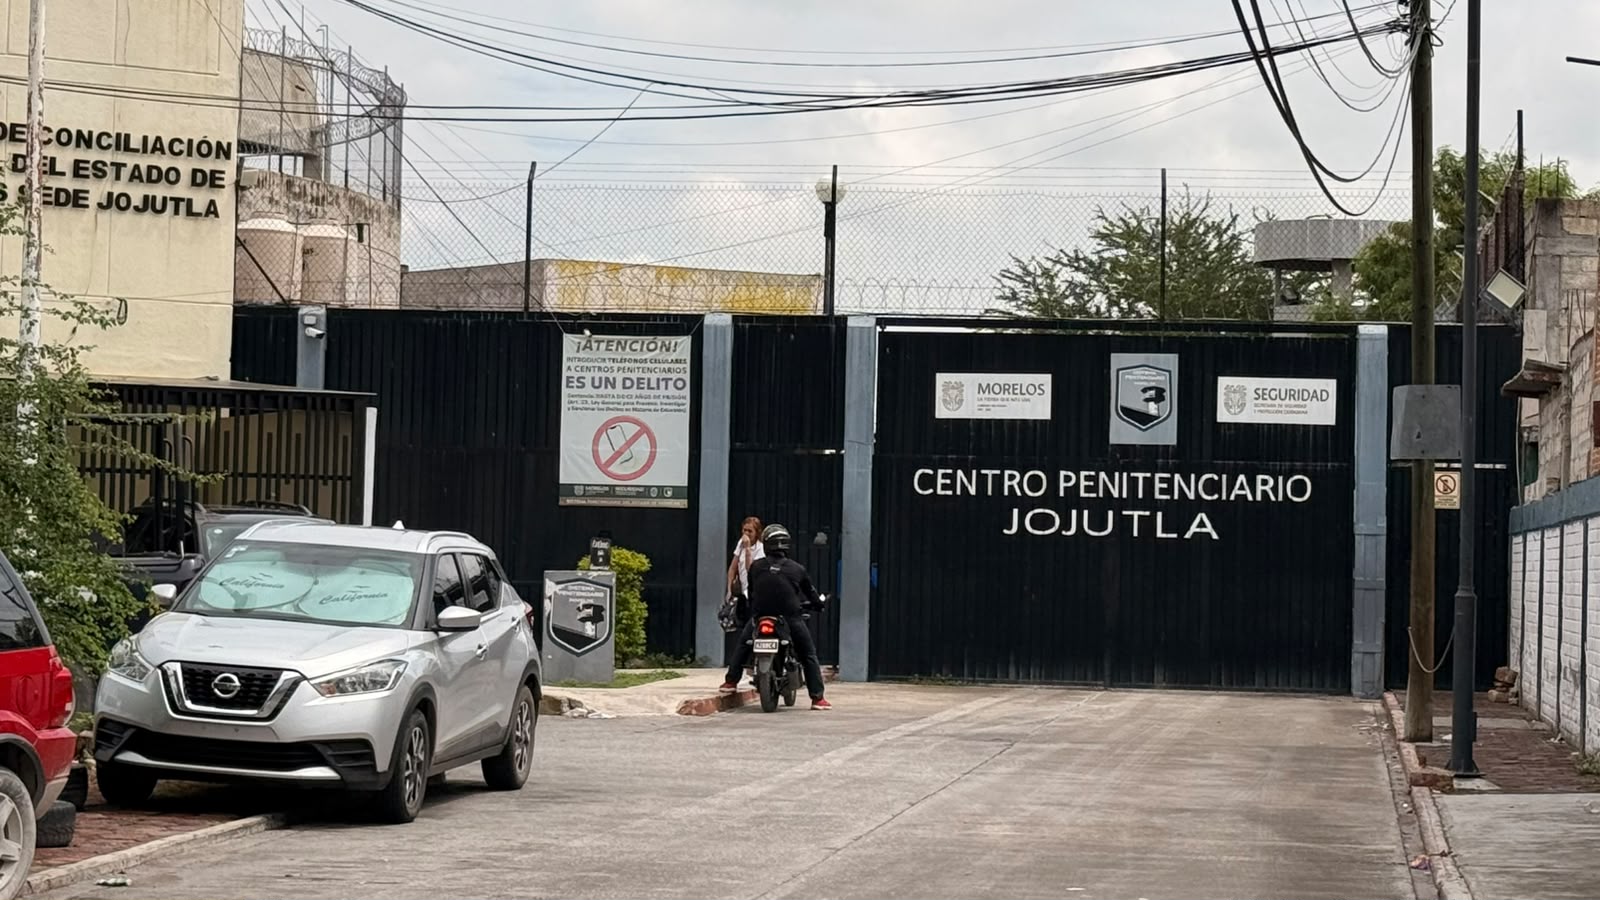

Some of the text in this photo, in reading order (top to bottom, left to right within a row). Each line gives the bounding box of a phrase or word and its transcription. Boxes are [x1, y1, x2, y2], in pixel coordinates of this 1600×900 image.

[42, 125, 232, 160] CONCILIACIÓN
[73, 158, 181, 186] ESTADO
[191, 168, 226, 189] DE
[97, 191, 220, 218] JOJUTLA
[576, 336, 678, 353] ¡ATENCIÓN!
[574, 365, 615, 373] CENTROS
[617, 366, 687, 375] PENITENCIARIOS
[565, 375, 687, 391] ES UN DELITO
[977, 382, 1045, 396] MORELOS
[1253, 387, 1330, 402] SEGURIDAD
[913, 468, 1312, 502] CENTRO PENITENCIARIO
[1002, 508, 1219, 539] JOJUTLA
[219, 576, 285, 589] California
[319, 592, 388, 605] California
